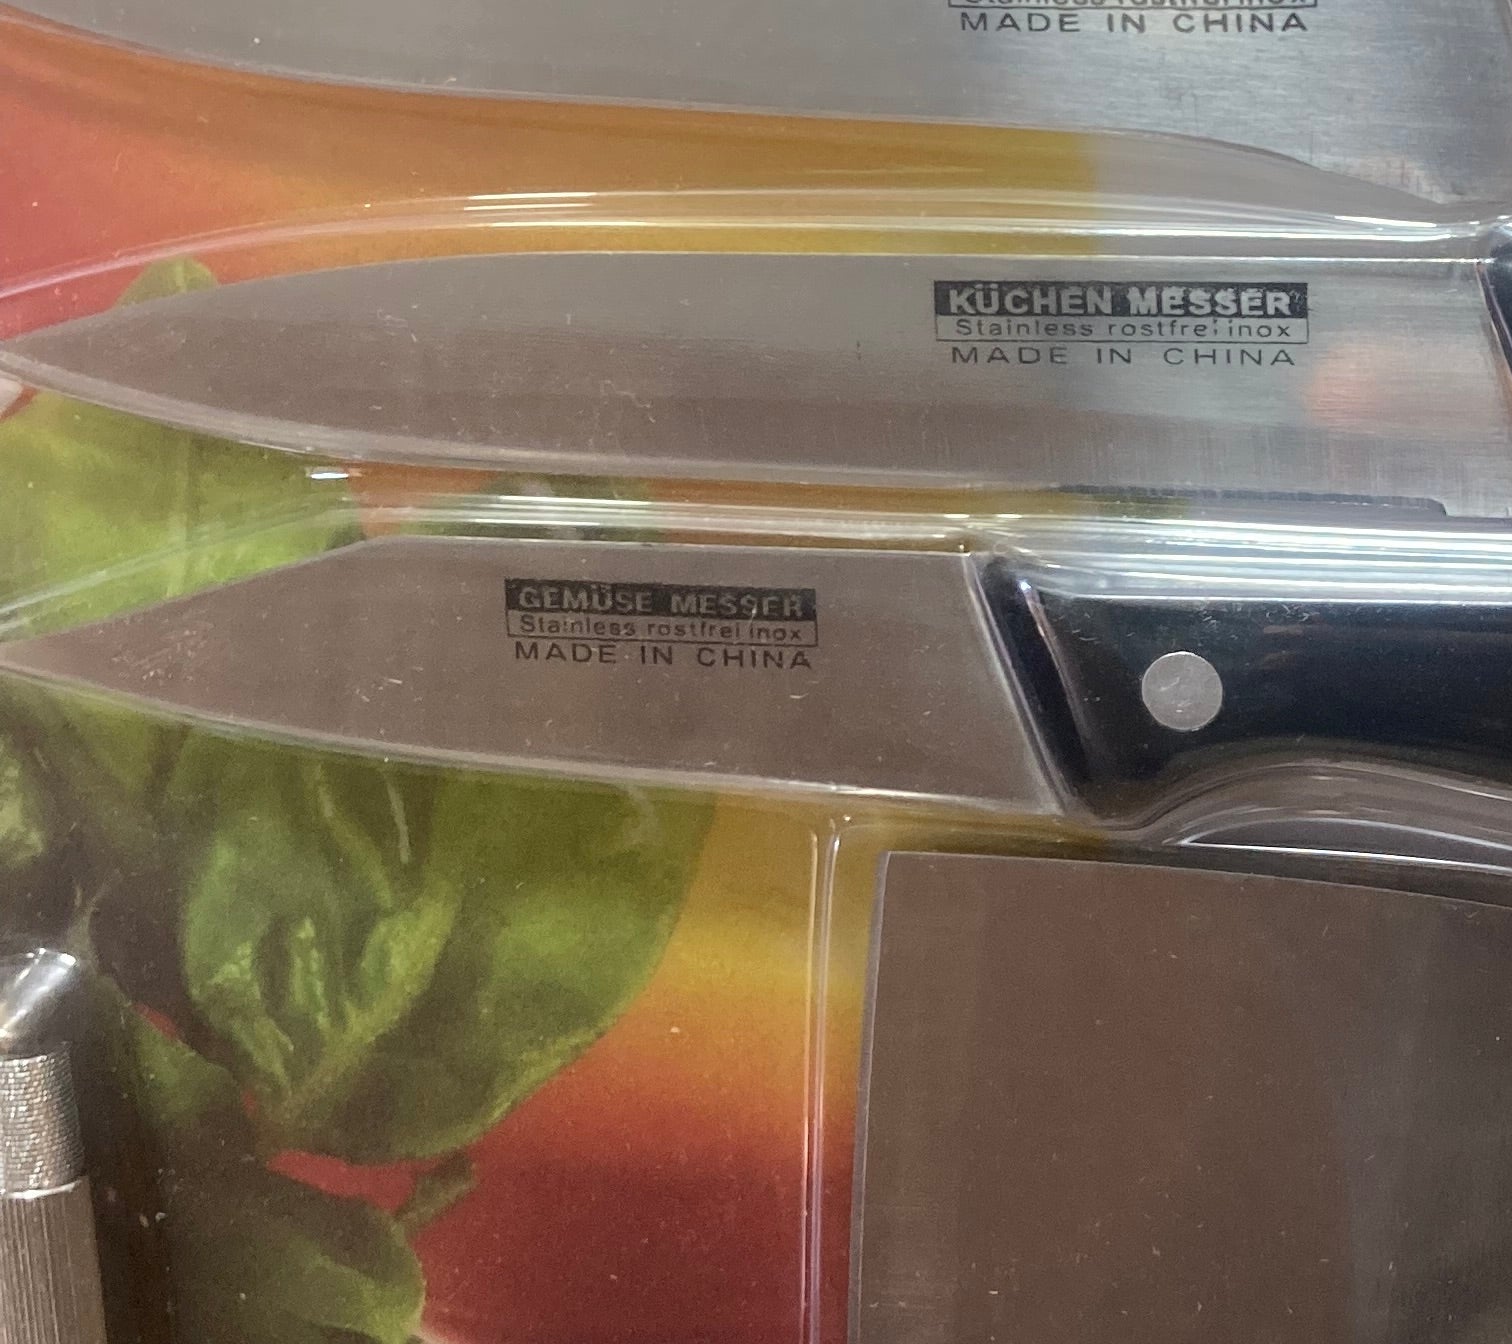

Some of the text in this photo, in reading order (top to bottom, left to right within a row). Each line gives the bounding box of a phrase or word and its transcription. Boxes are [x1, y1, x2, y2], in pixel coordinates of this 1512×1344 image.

[961, 12, 1309, 33] MADE IN CHINA
[948, 283, 1293, 316] KÜCHEN MESSER
[956, 318, 1291, 338] Stainless rostfrei inox
[951, 346, 1297, 366] MADE IN CHINA
[518, 584, 803, 618] GEMÜSE MESSER
[519, 613, 636, 636] Stainless
[514, 641, 813, 670] MADE IN CHINA
